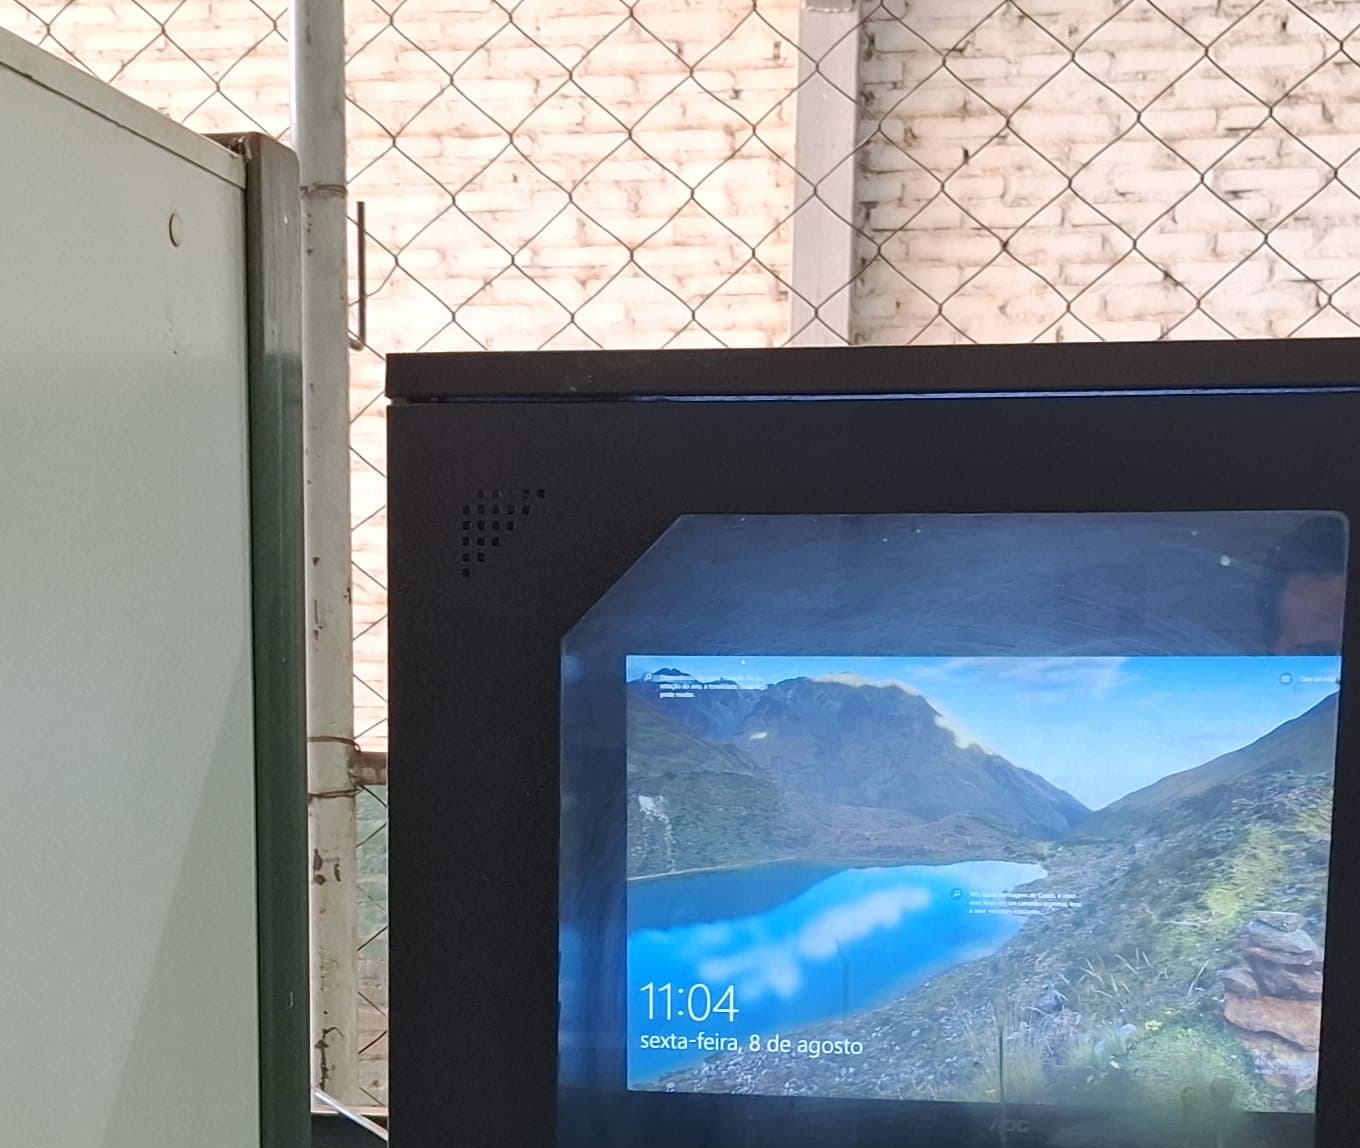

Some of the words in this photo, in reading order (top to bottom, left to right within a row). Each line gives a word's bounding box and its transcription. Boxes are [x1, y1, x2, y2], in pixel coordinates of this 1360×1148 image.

[640, 981, 740, 1023] 11:04
[640, 1032, 743, 1054] sexta-feira,
[749, 1034, 761, 1053] 8
[766, 1034, 791, 1053] de
[797, 1037, 863, 1058] agosto
